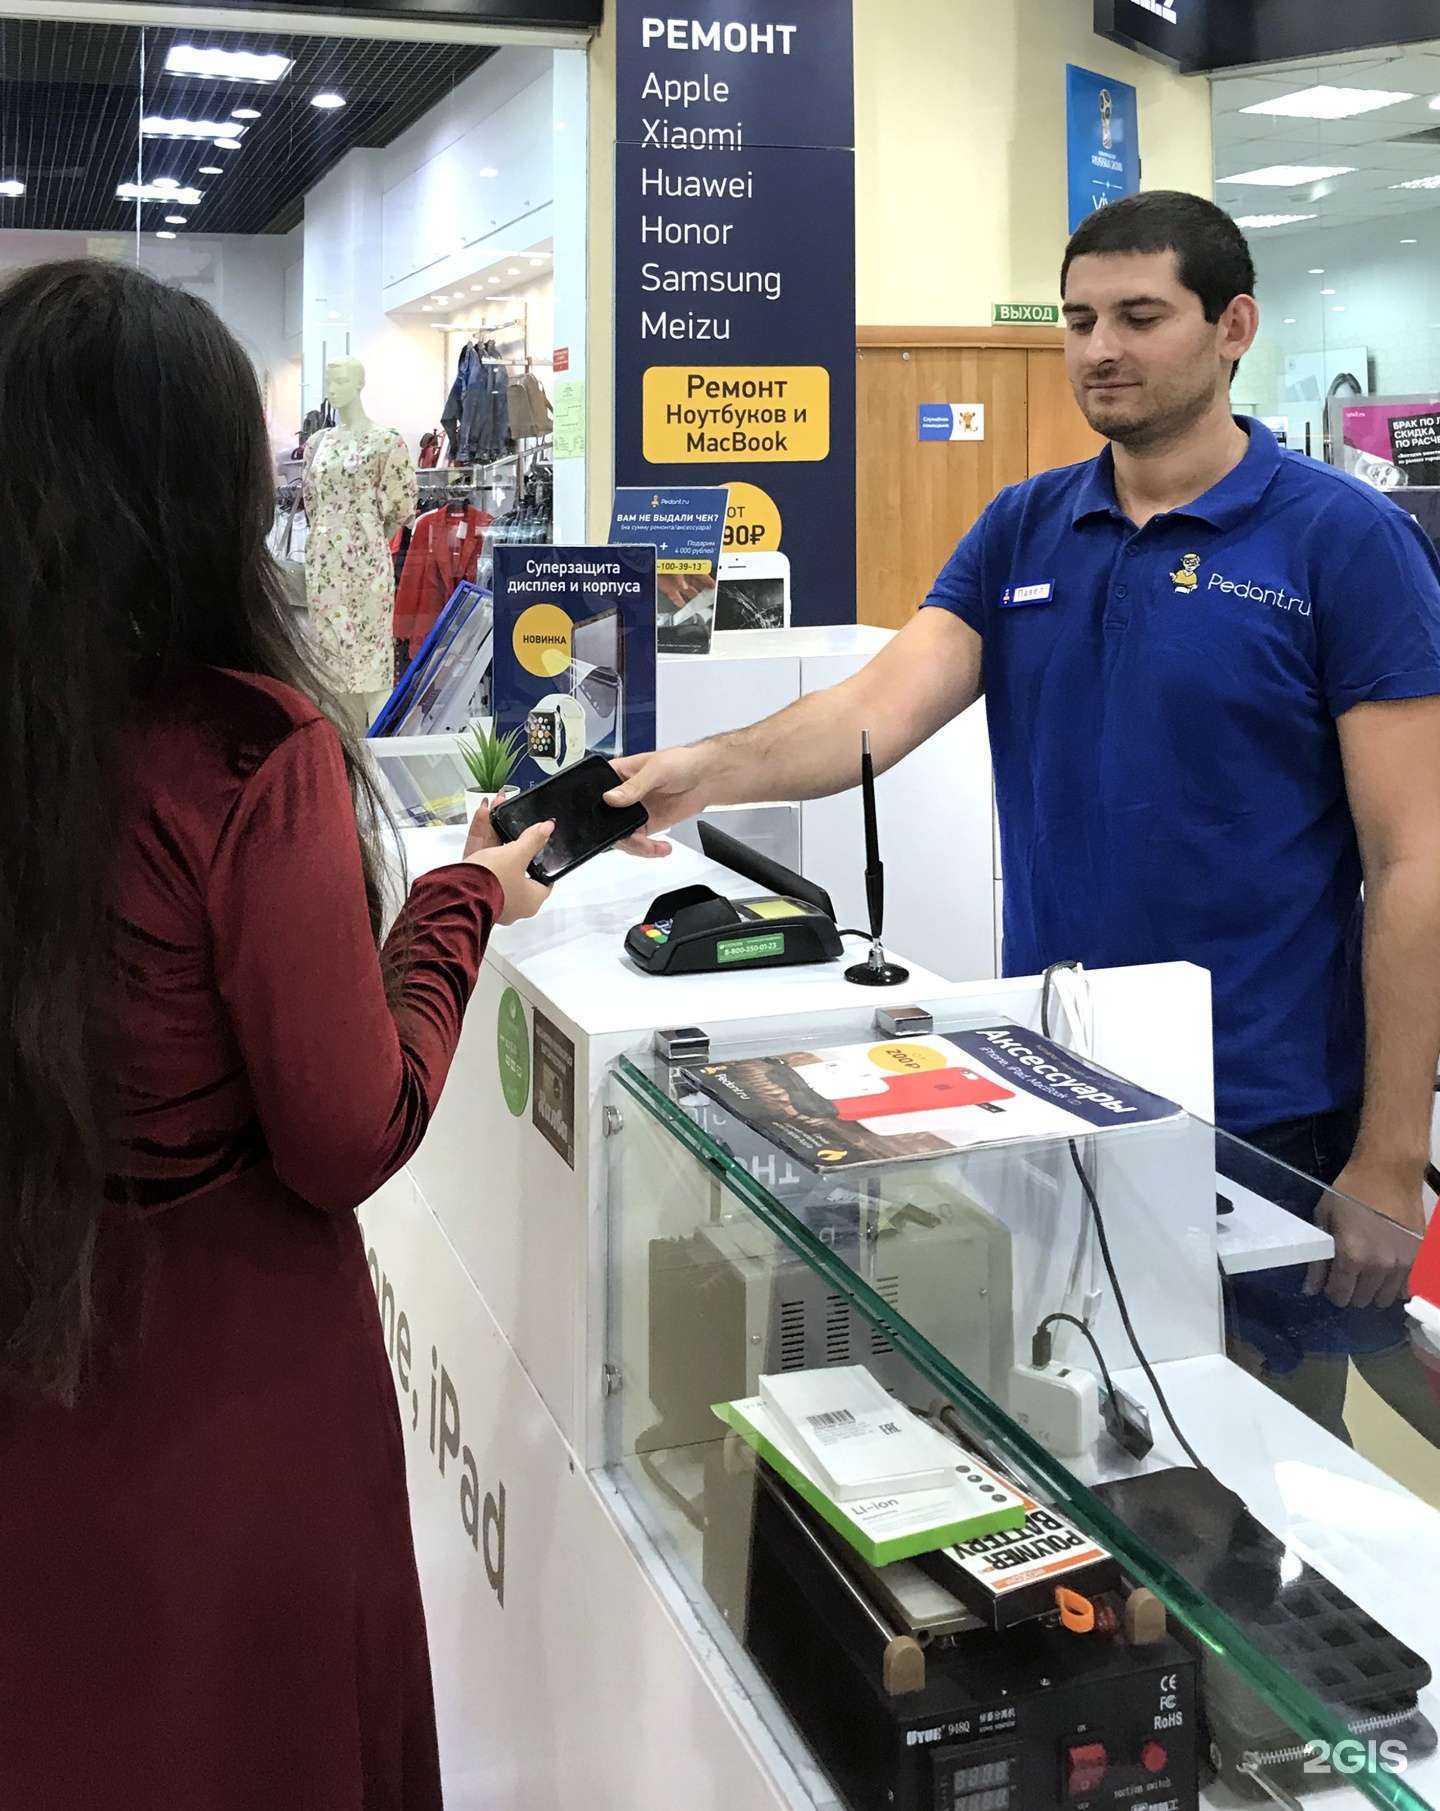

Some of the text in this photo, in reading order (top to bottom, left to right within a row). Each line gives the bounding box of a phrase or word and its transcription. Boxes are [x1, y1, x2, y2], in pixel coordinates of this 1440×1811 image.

[641, 17, 797, 55] РЕМОНТ
[641, 72, 729, 108] Apple
[641, 118, 743, 151] Xiaomi
[641, 167, 753, 199] Huawei
[641, 215, 734, 245] Honor
[640, 262, 781, 301] Samsung
[641, 311, 731, 340] Meizu
[1000, 305, 1053, 321] ВЫХОД
[687, 374, 788, 399] Ремонт
[666, 403, 807, 430] Ноутбуков и
[1392, 419, 1418, 430] БРАК
[1420, 417, 1435, 427] ПО
[686, 431, 788, 453] MacBook
[1394, 427, 1436, 440] СКИДКА
[1395, 439, 1410, 448] ПО
[616, 513, 719, 523] ВАМ НЕ ВЫДАЛИ ЧЕК?
[525, 559, 621, 577] Суперзащита
[507, 580, 641, 596] дисплея и корпуса
[1207, 573, 1312, 617] Pedant.ru
[522, 634, 567, 645] НОВИНКА
[975, 1030, 1139, 1114] Аксессуары
[429, 1344, 506, 1611] iPad
[951, 1510, 1065, 1560] BATTERY
[981, 1530, 1086, 1570] POLYMER
[1153, 1711, 1184, 1730] RoHS
